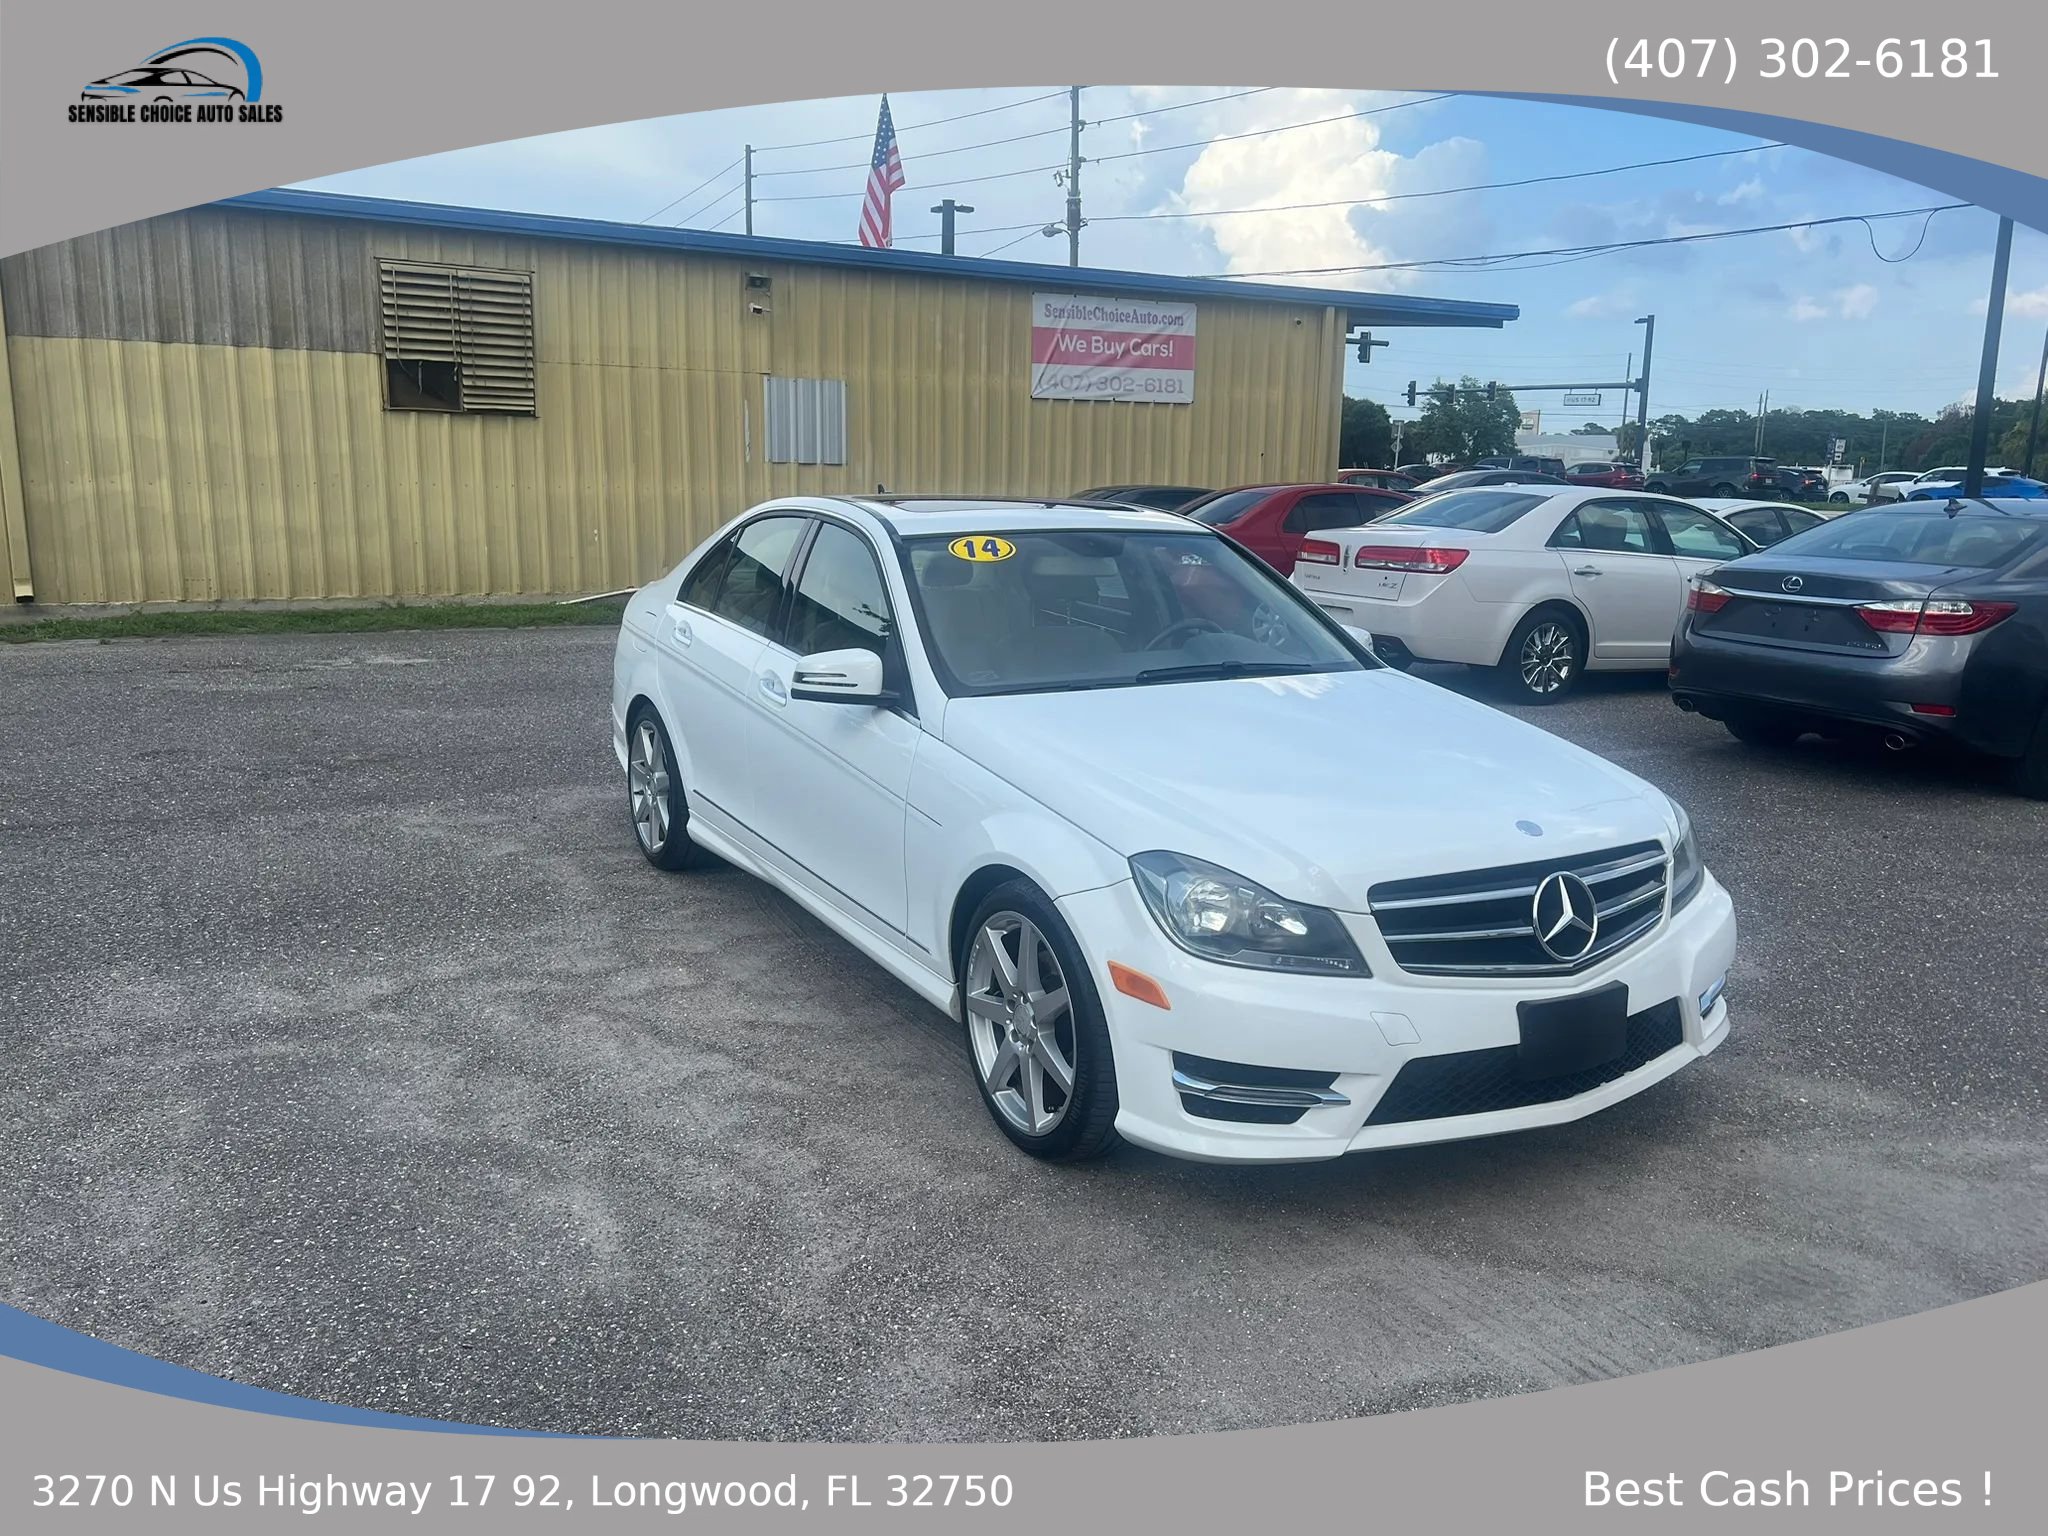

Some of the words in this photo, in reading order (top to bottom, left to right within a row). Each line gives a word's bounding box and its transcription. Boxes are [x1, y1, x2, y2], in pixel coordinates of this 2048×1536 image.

[1044, 303, 1184, 327] SensibleChoiceAuto.com
[1057, 333, 1087, 353] We
[1091, 335, 1125, 359] Buy
[1129, 338, 1174, 358] Cars!
[1096, 375, 1184, 395] 302-6181
[963, 539, 1000, 559] 14
